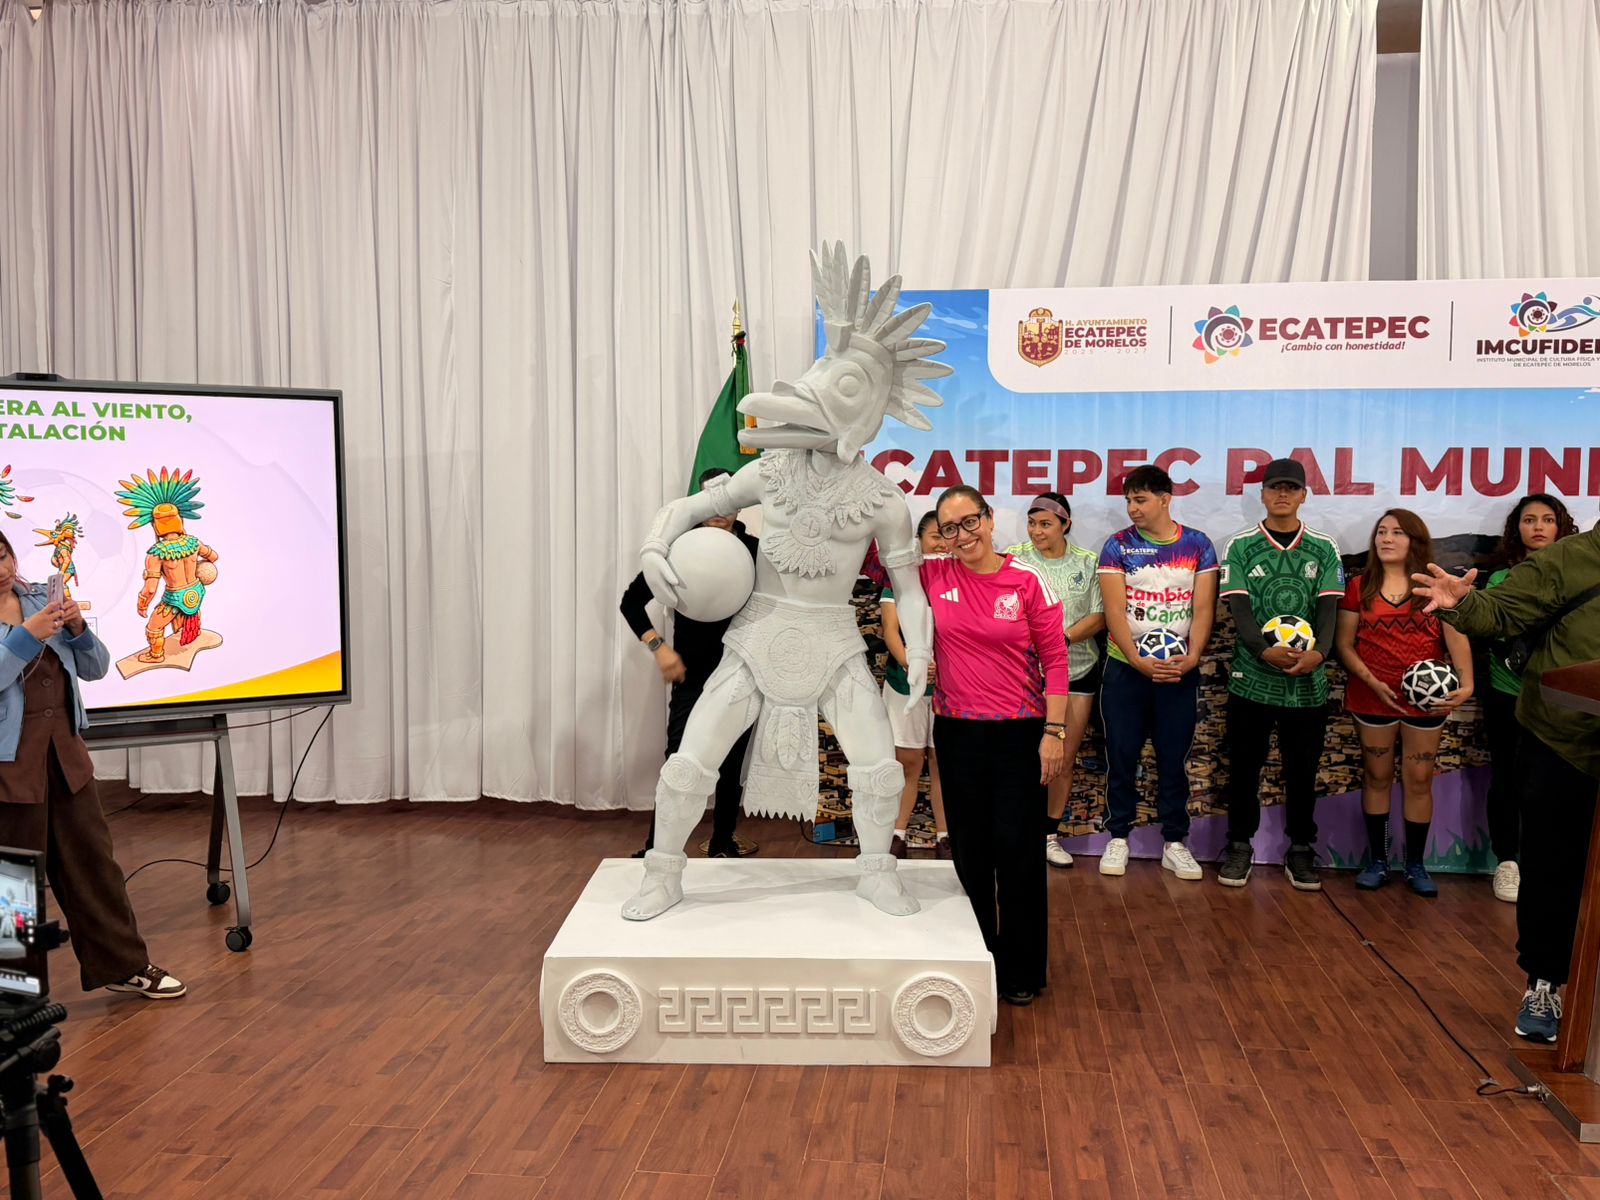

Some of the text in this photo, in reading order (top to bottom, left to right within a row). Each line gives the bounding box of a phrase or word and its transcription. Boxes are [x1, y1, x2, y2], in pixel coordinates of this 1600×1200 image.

[1076, 318, 1147, 326] AYUNTAMIENTO
[1259, 315, 1431, 341] ECATEPEC
[1065, 326, 1147, 339] ECATEPEC
[1065, 338, 1147, 348] DE MORELOS
[1281, 341, 1406, 353] ¡Cambio con honestidad!
[51, 401, 86, 417] AL
[92, 402, 193, 423] VIENTO,
[1400, 447, 1600, 497] MUN
